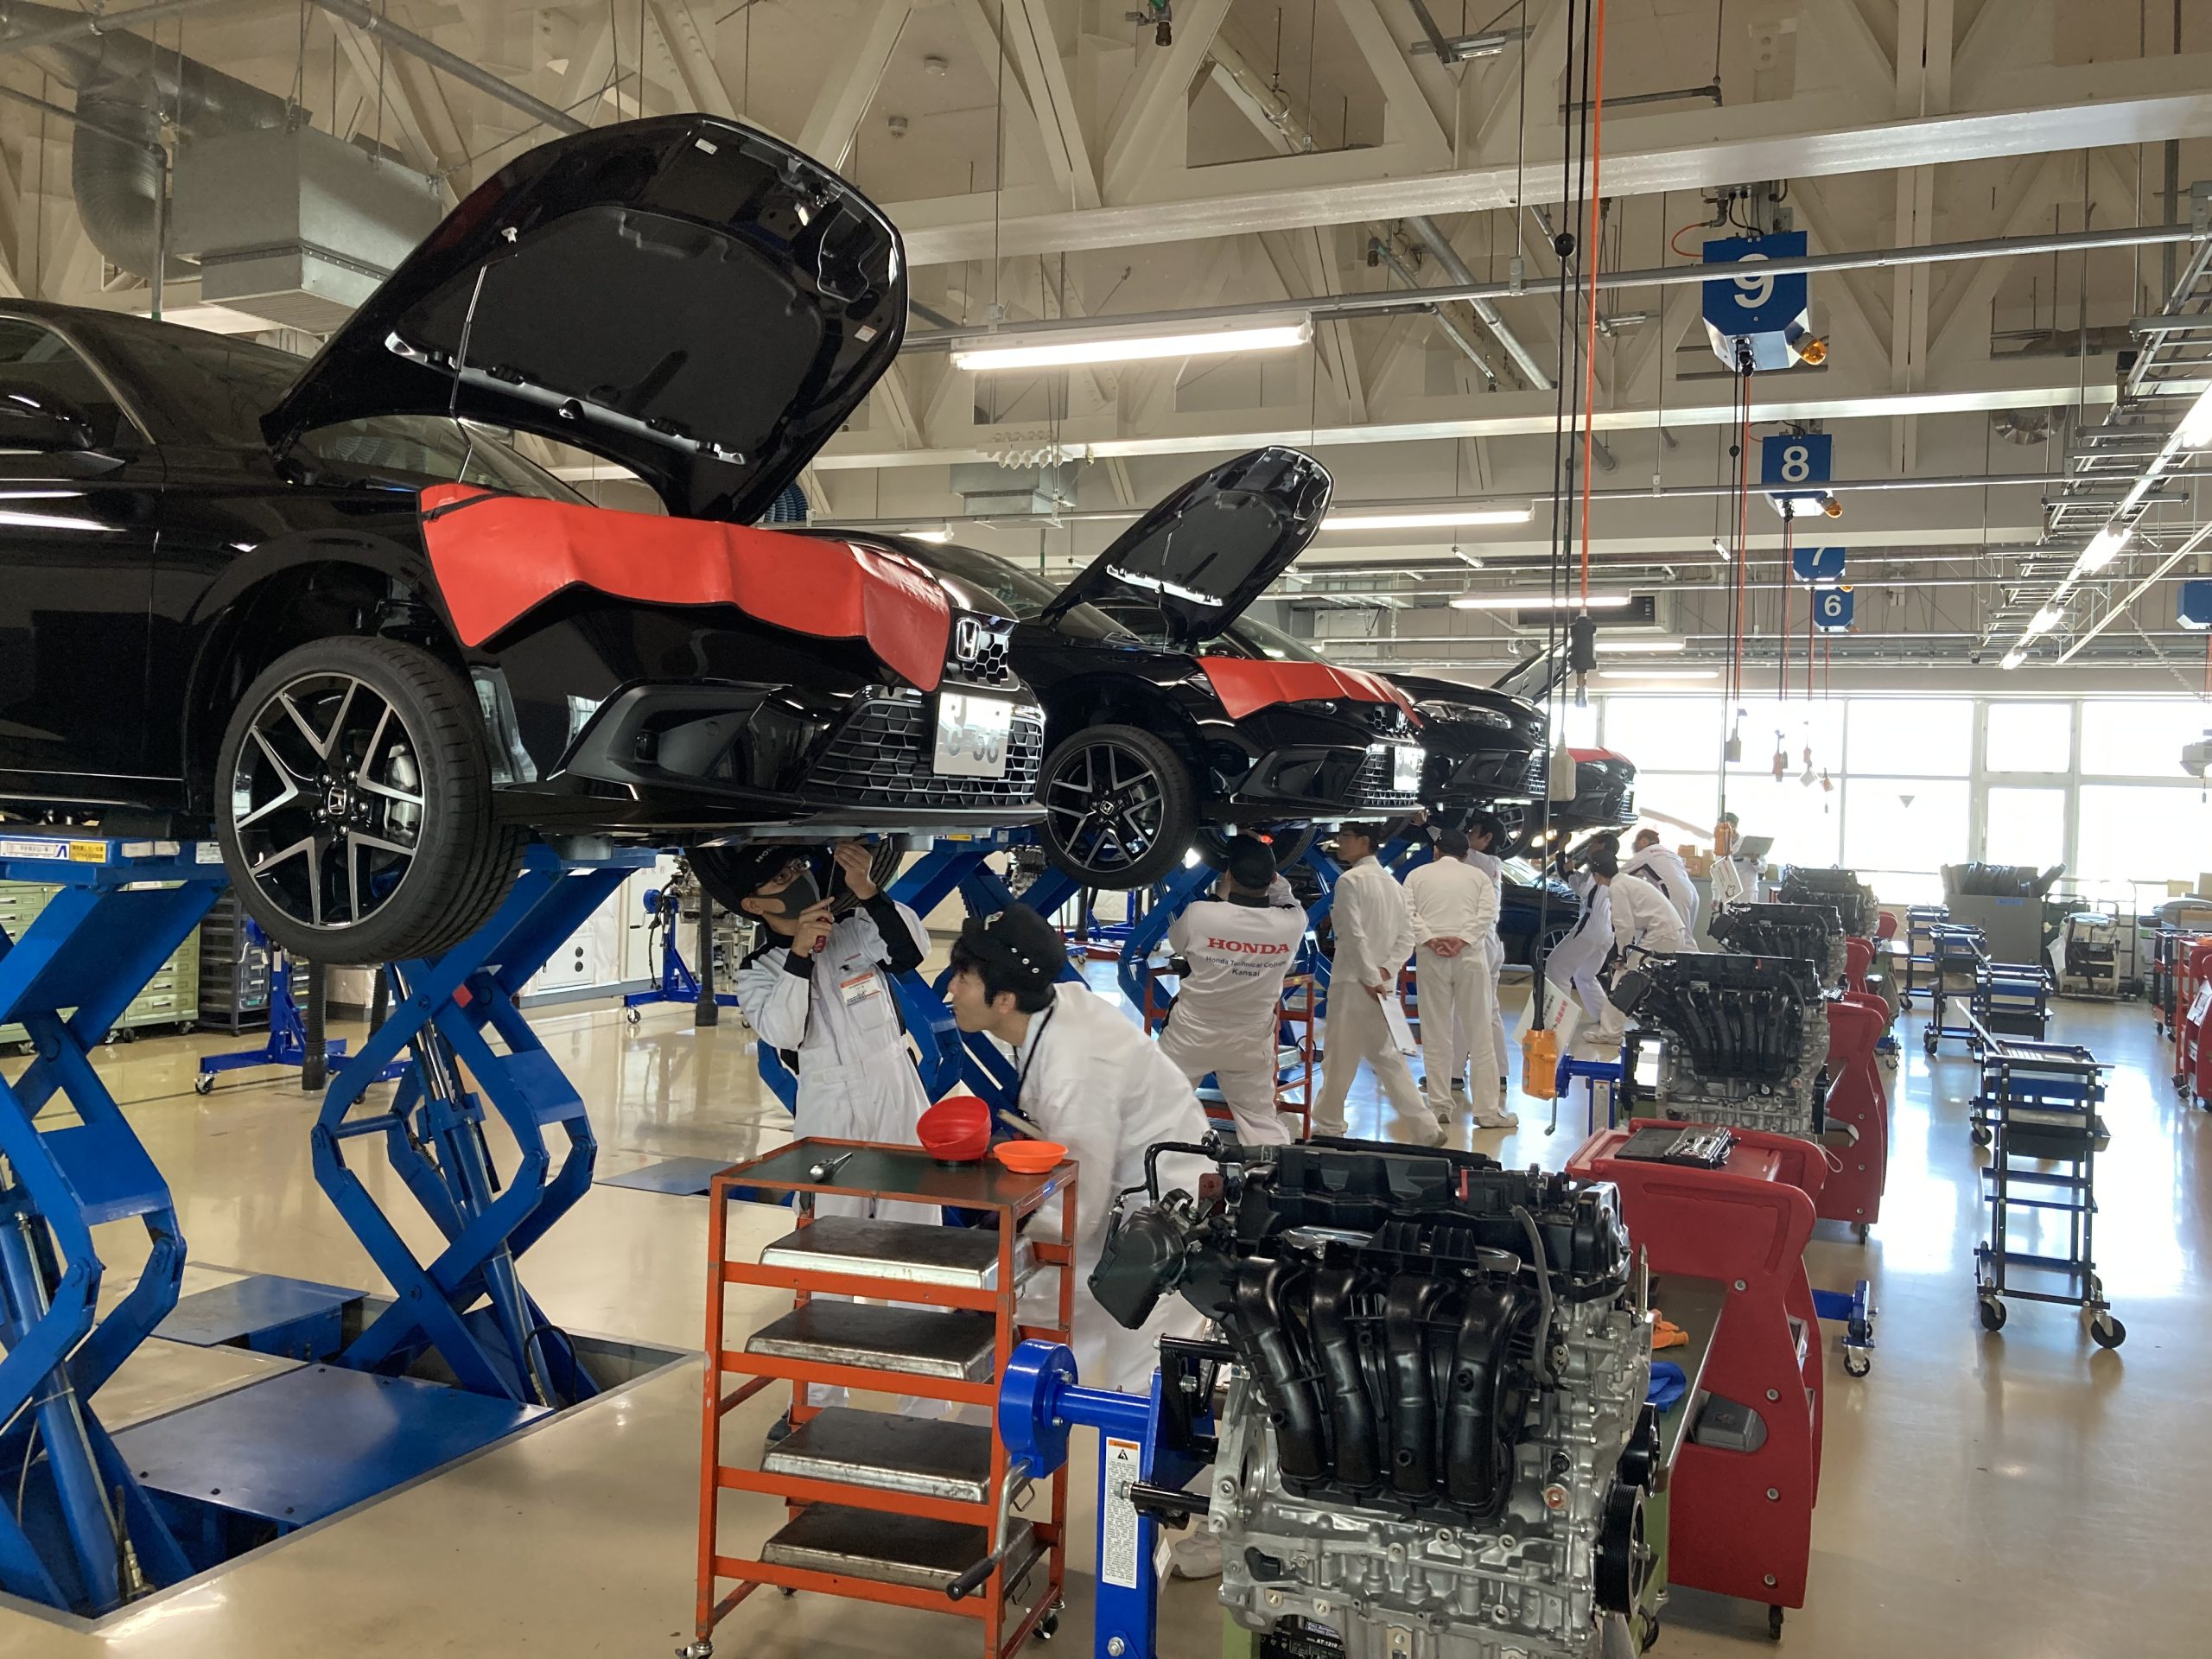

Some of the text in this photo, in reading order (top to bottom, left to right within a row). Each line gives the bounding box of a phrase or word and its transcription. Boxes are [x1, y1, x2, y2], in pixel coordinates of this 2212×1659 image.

[1733, 253, 1775, 308] 9
[1781, 445, 1810, 482] 8
[1811, 547, 1827, 567] 7
[1823, 594, 1842, 617] 6
[1206, 937, 1290, 955] HONDA
[1205, 956, 1229, 965] Honda
[1231, 968, 1260, 977] Kansai
